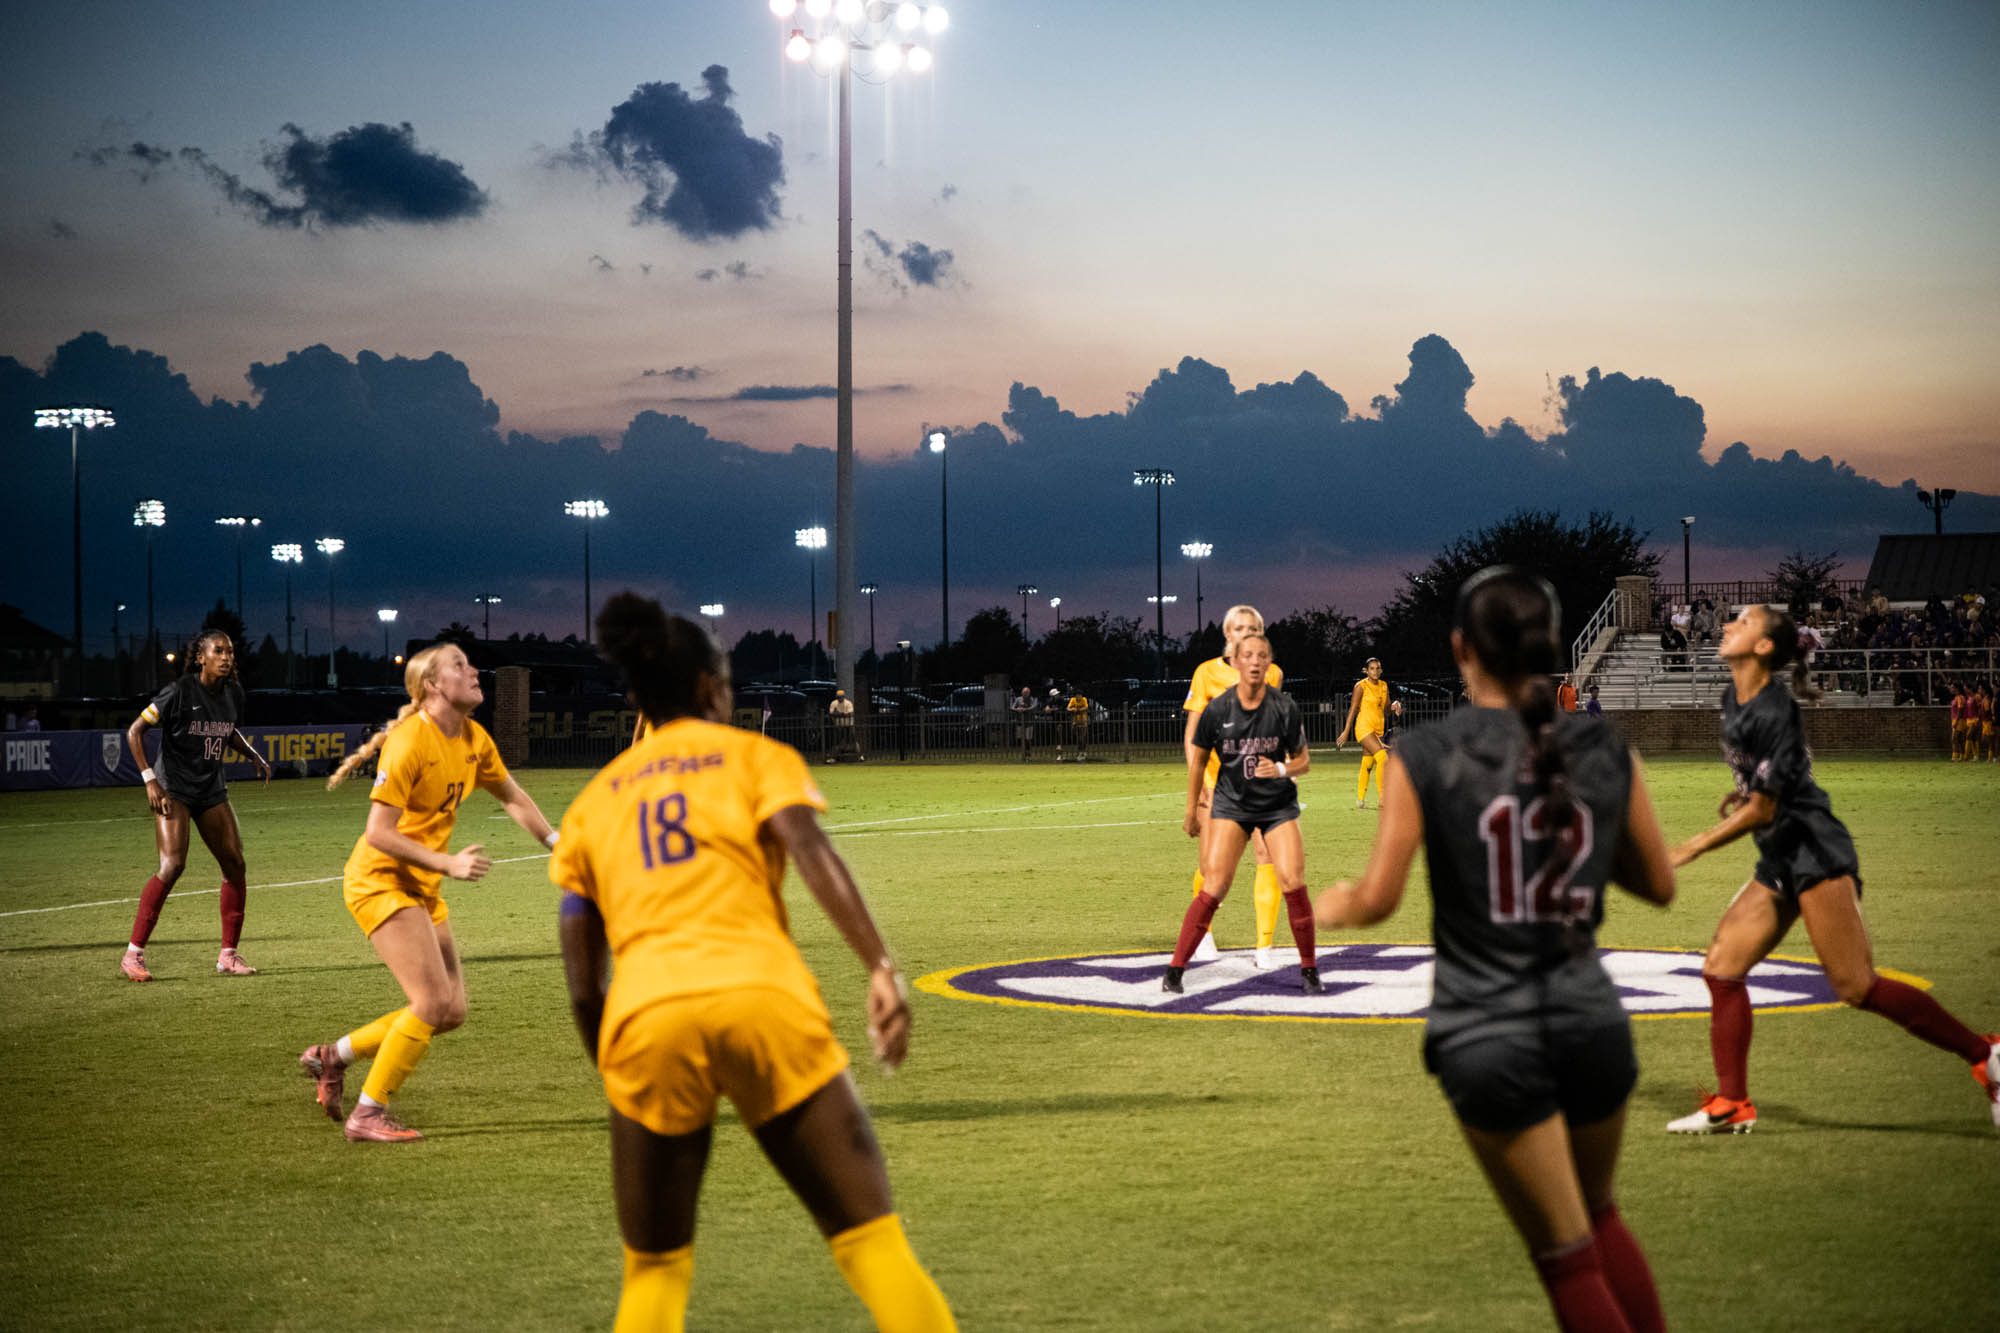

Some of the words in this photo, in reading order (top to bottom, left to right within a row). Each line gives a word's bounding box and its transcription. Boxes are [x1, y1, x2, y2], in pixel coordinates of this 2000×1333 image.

[188, 720, 235, 736] ALABAM
[6, 740, 51, 772] PRIDE
[203, 737, 223, 760] 14
[264, 732, 345, 761] TIGERS
[639, 793, 696, 870] 18
[1478, 794, 1596, 924] 12
